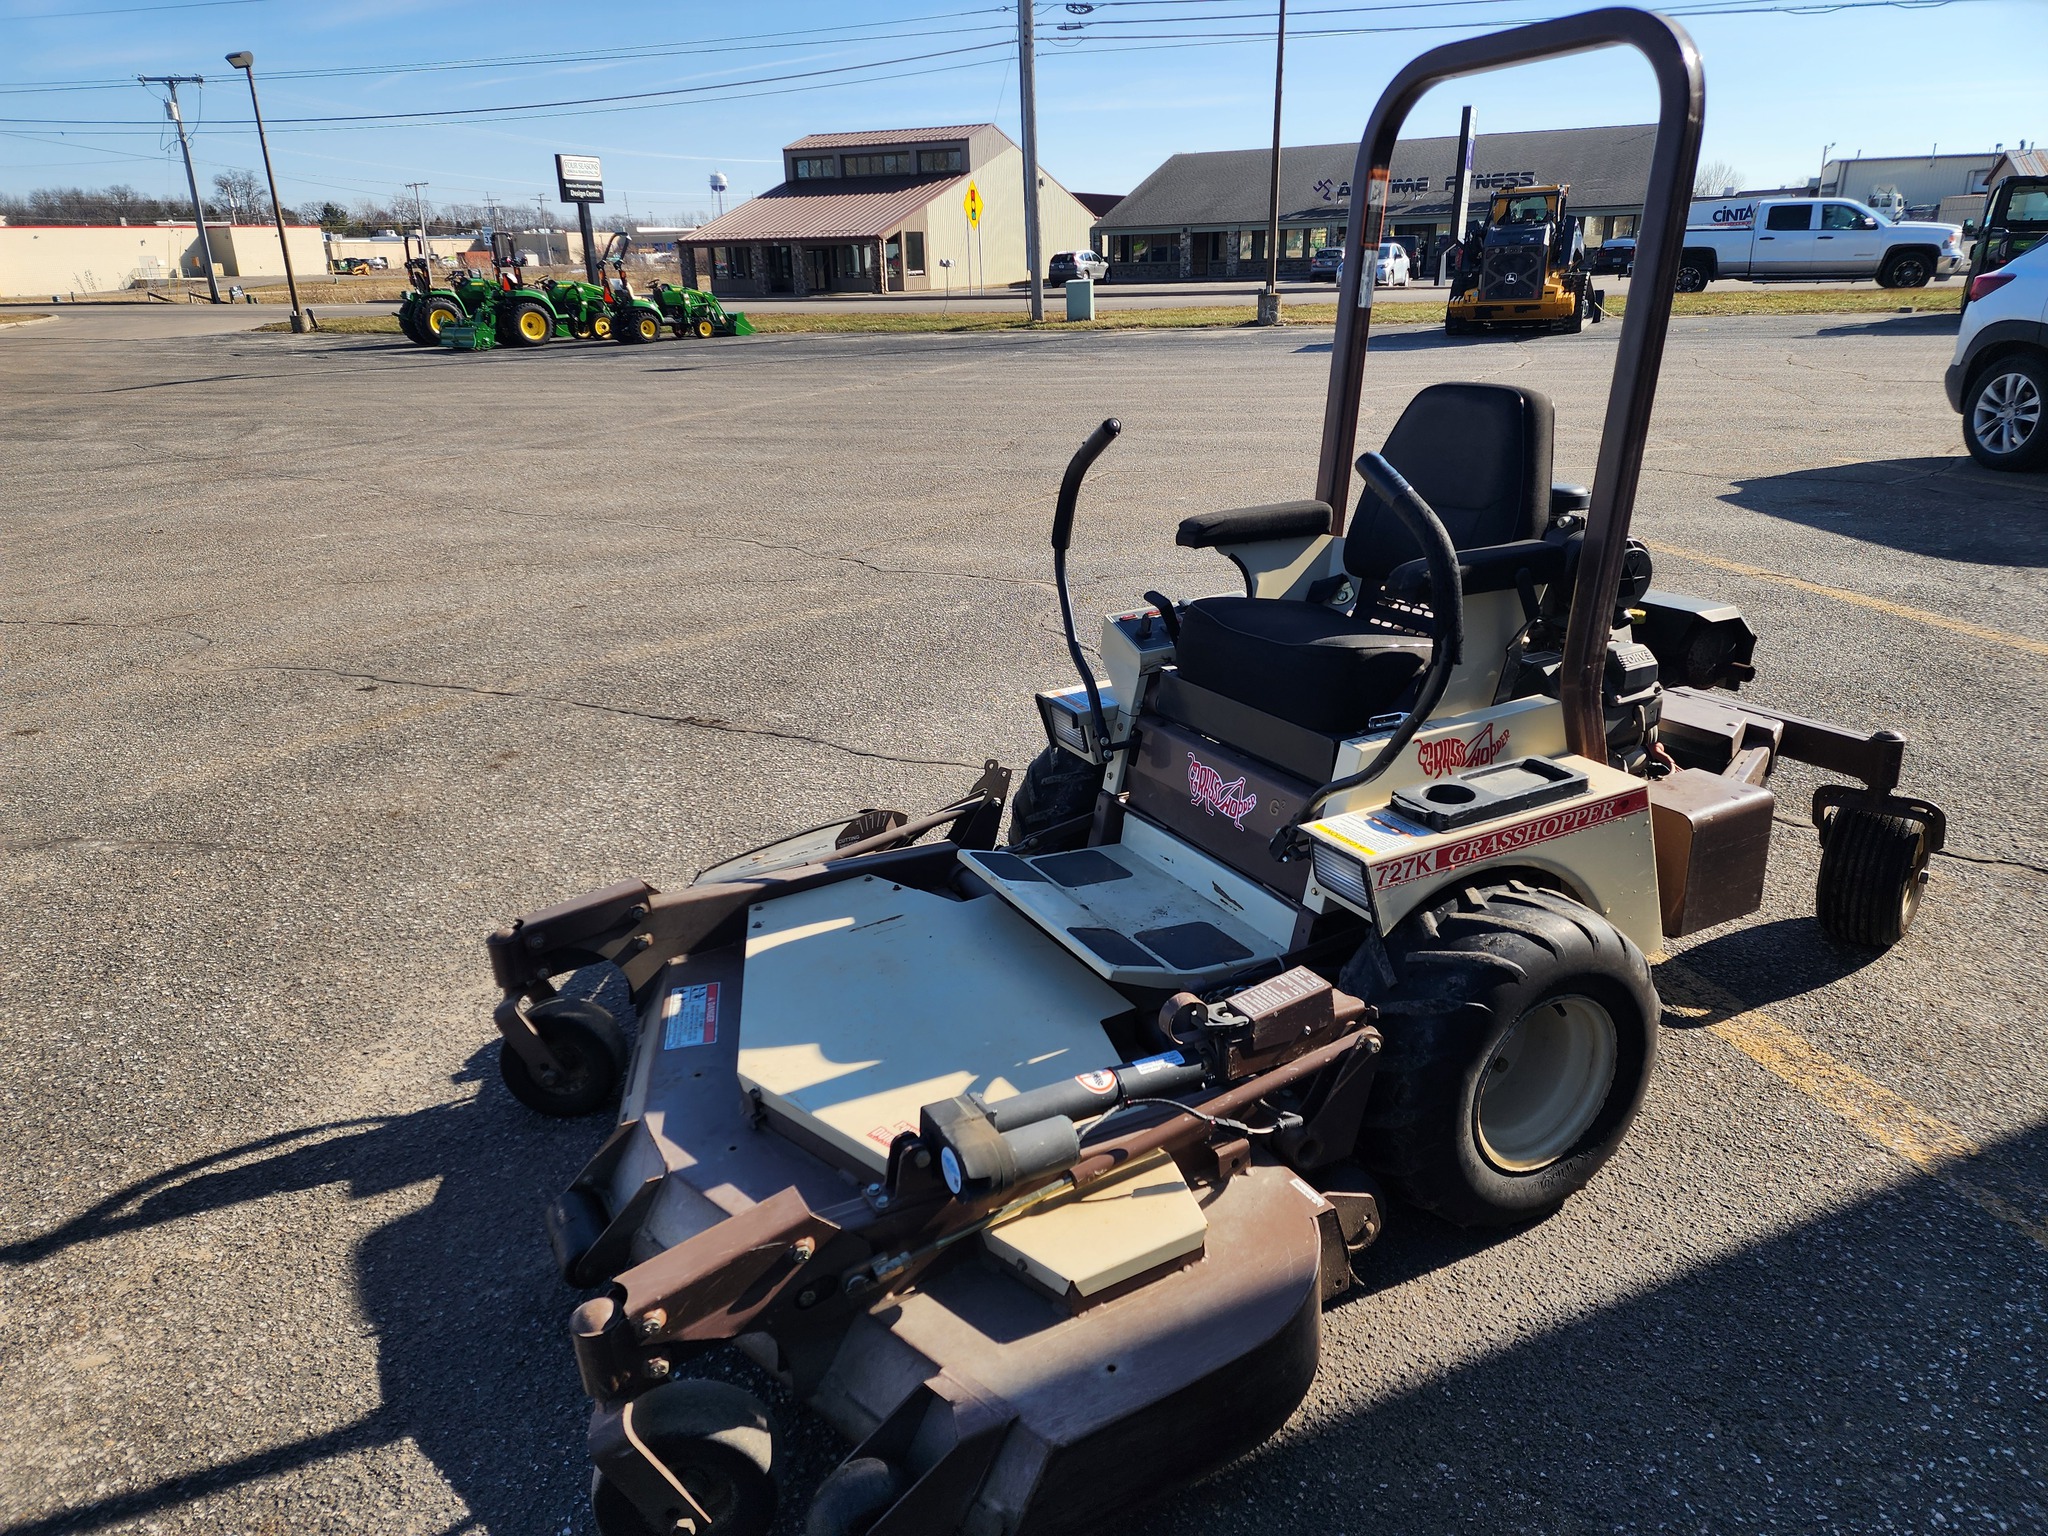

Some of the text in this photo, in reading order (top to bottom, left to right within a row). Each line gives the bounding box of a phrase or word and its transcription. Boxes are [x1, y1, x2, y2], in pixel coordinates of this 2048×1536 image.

[565, 161, 578, 169] FOUR
[1445, 171, 1535, 191] FNESS
[570, 190, 585, 199] Design
[1413, 722, 1510, 780] GRASSHOPPER
[1188, 752, 1257, 832] GRASSHOPPER
[838, 835, 860, 844] CUTTING
[1376, 852, 1432, 886] 727K
[1448, 801, 1616, 864] GRASSHOPPER
